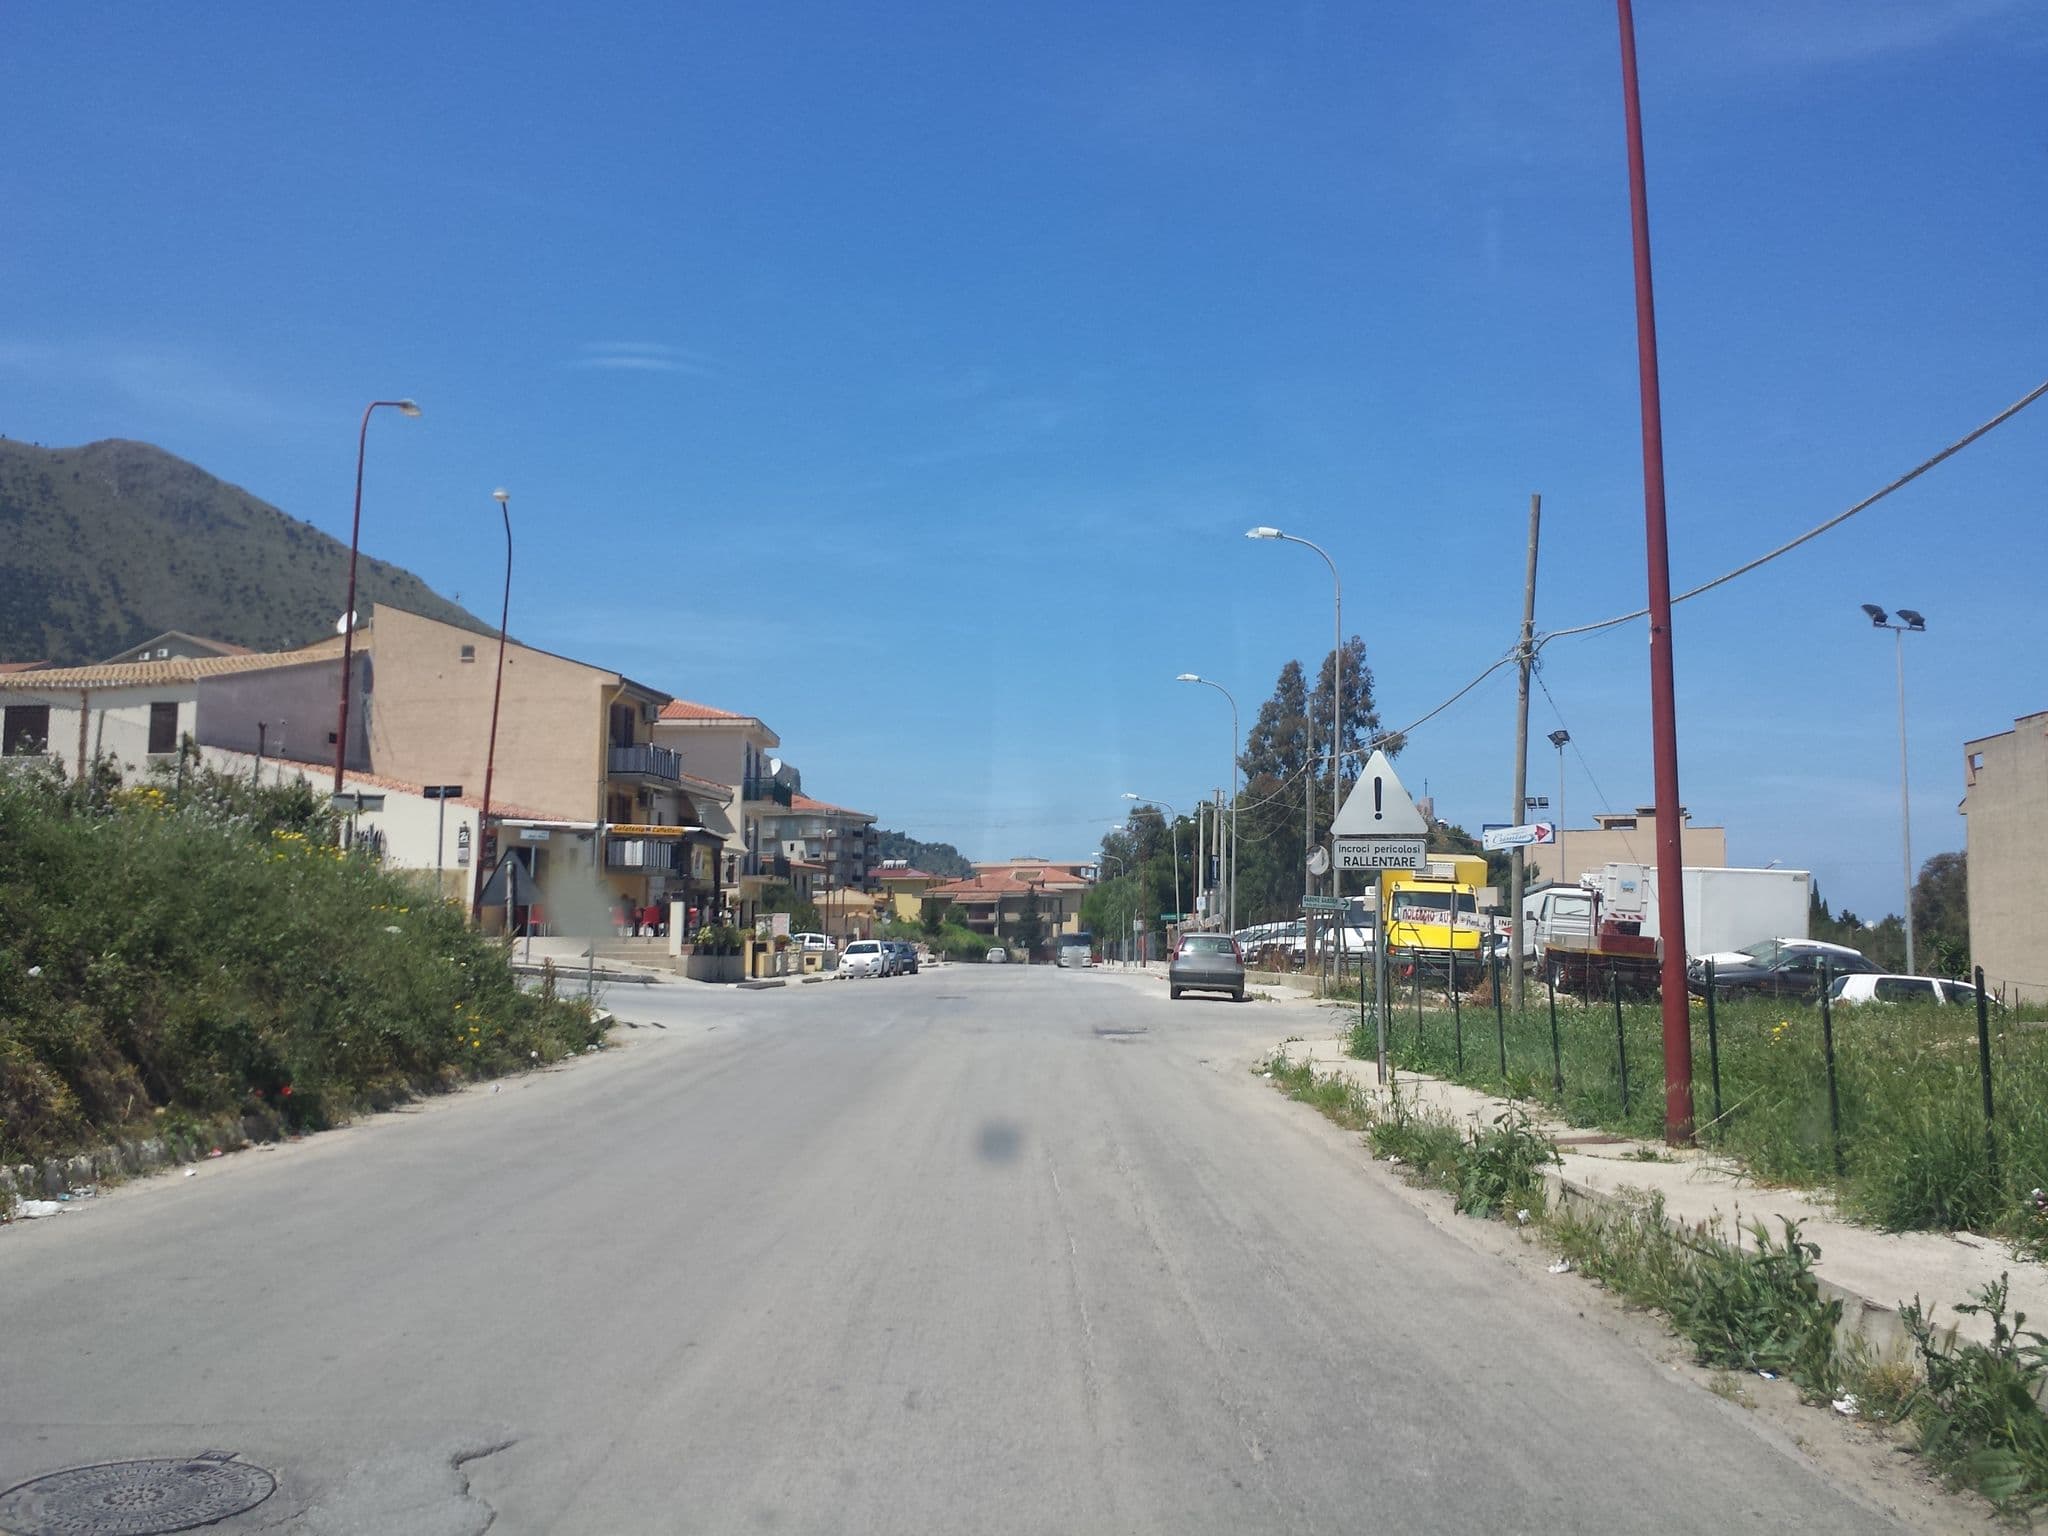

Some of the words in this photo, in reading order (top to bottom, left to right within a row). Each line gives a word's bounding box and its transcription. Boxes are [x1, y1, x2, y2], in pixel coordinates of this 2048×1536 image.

[1338, 844, 1370, 853] incroci
[1374, 844, 1420, 855] pericolosi
[1343, 856, 1417, 867] RALLENTARE
[1438, 911, 1458, 925] AUO
